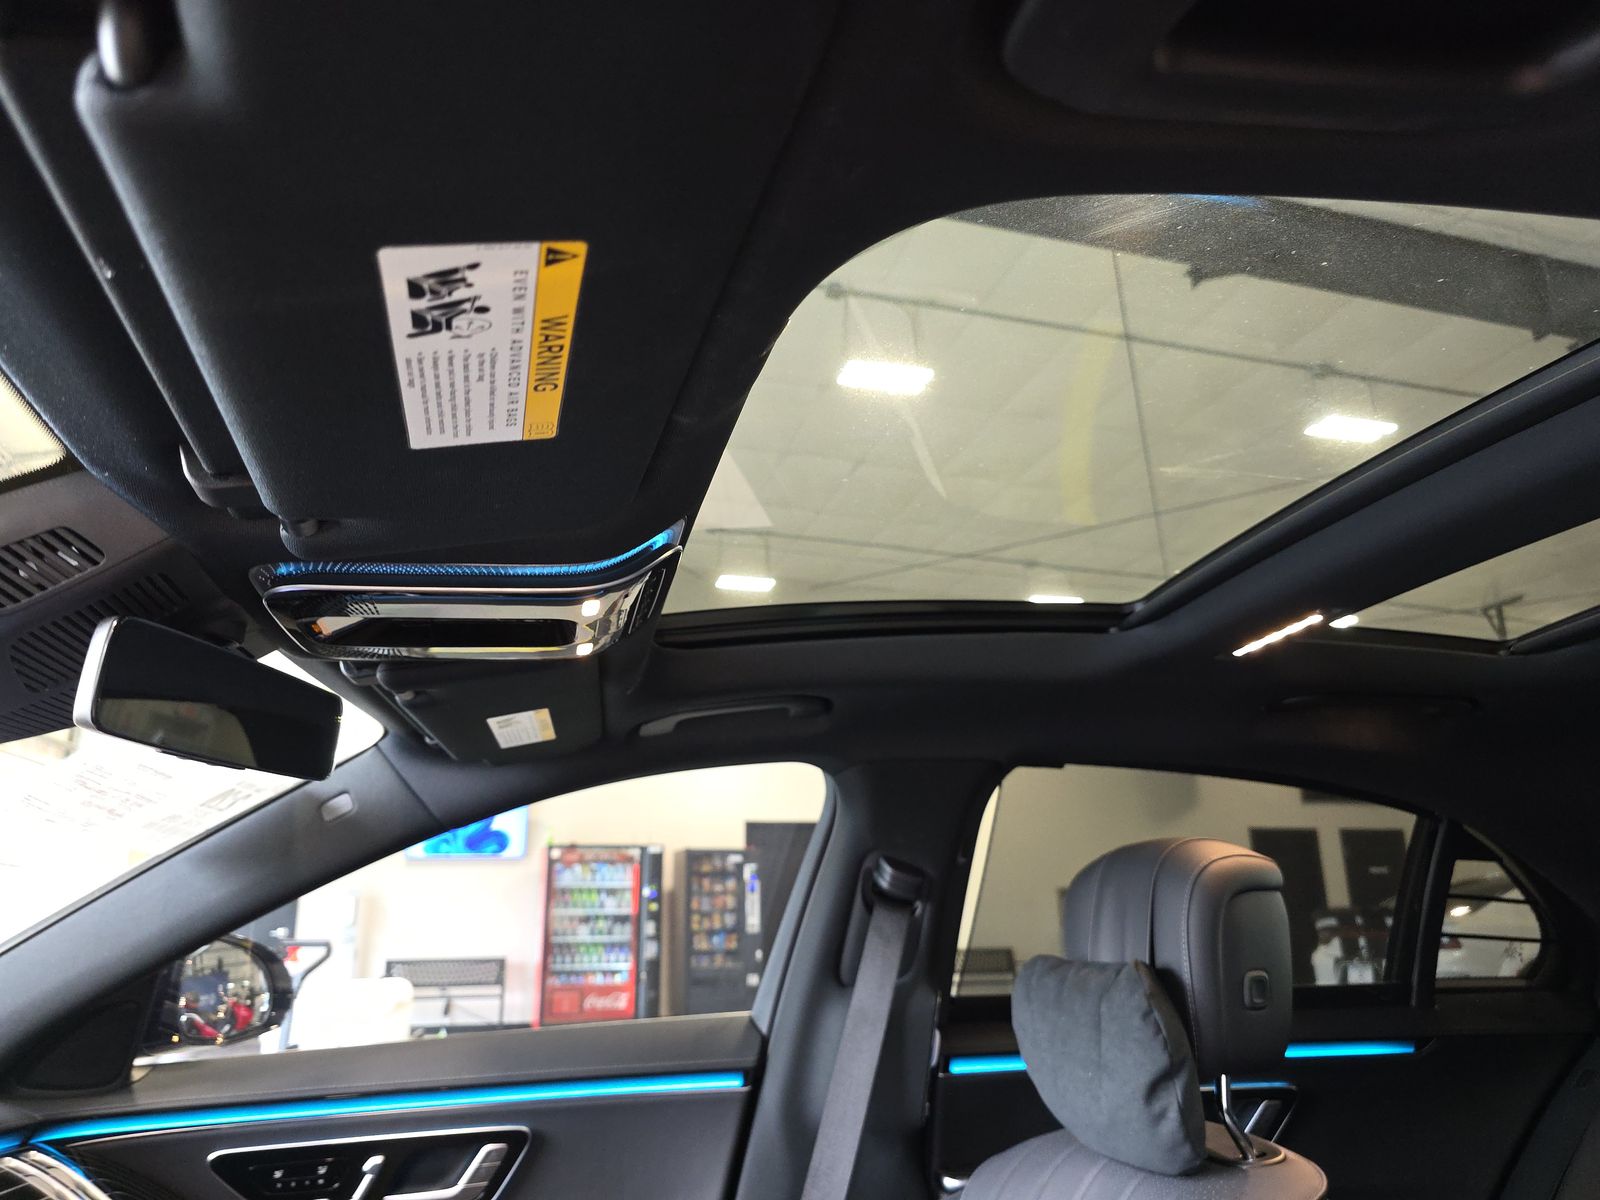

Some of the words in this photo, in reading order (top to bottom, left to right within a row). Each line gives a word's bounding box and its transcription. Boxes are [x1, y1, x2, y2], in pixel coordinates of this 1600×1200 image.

[512, 269, 529, 300] EVEN
[511, 306, 525, 333] WITH
[508, 338, 523, 387] ADVANCED
[533, 314, 569, 393] WARNING
[507, 390, 519, 406] AIR
[505, 407, 519, 427] BAGS
